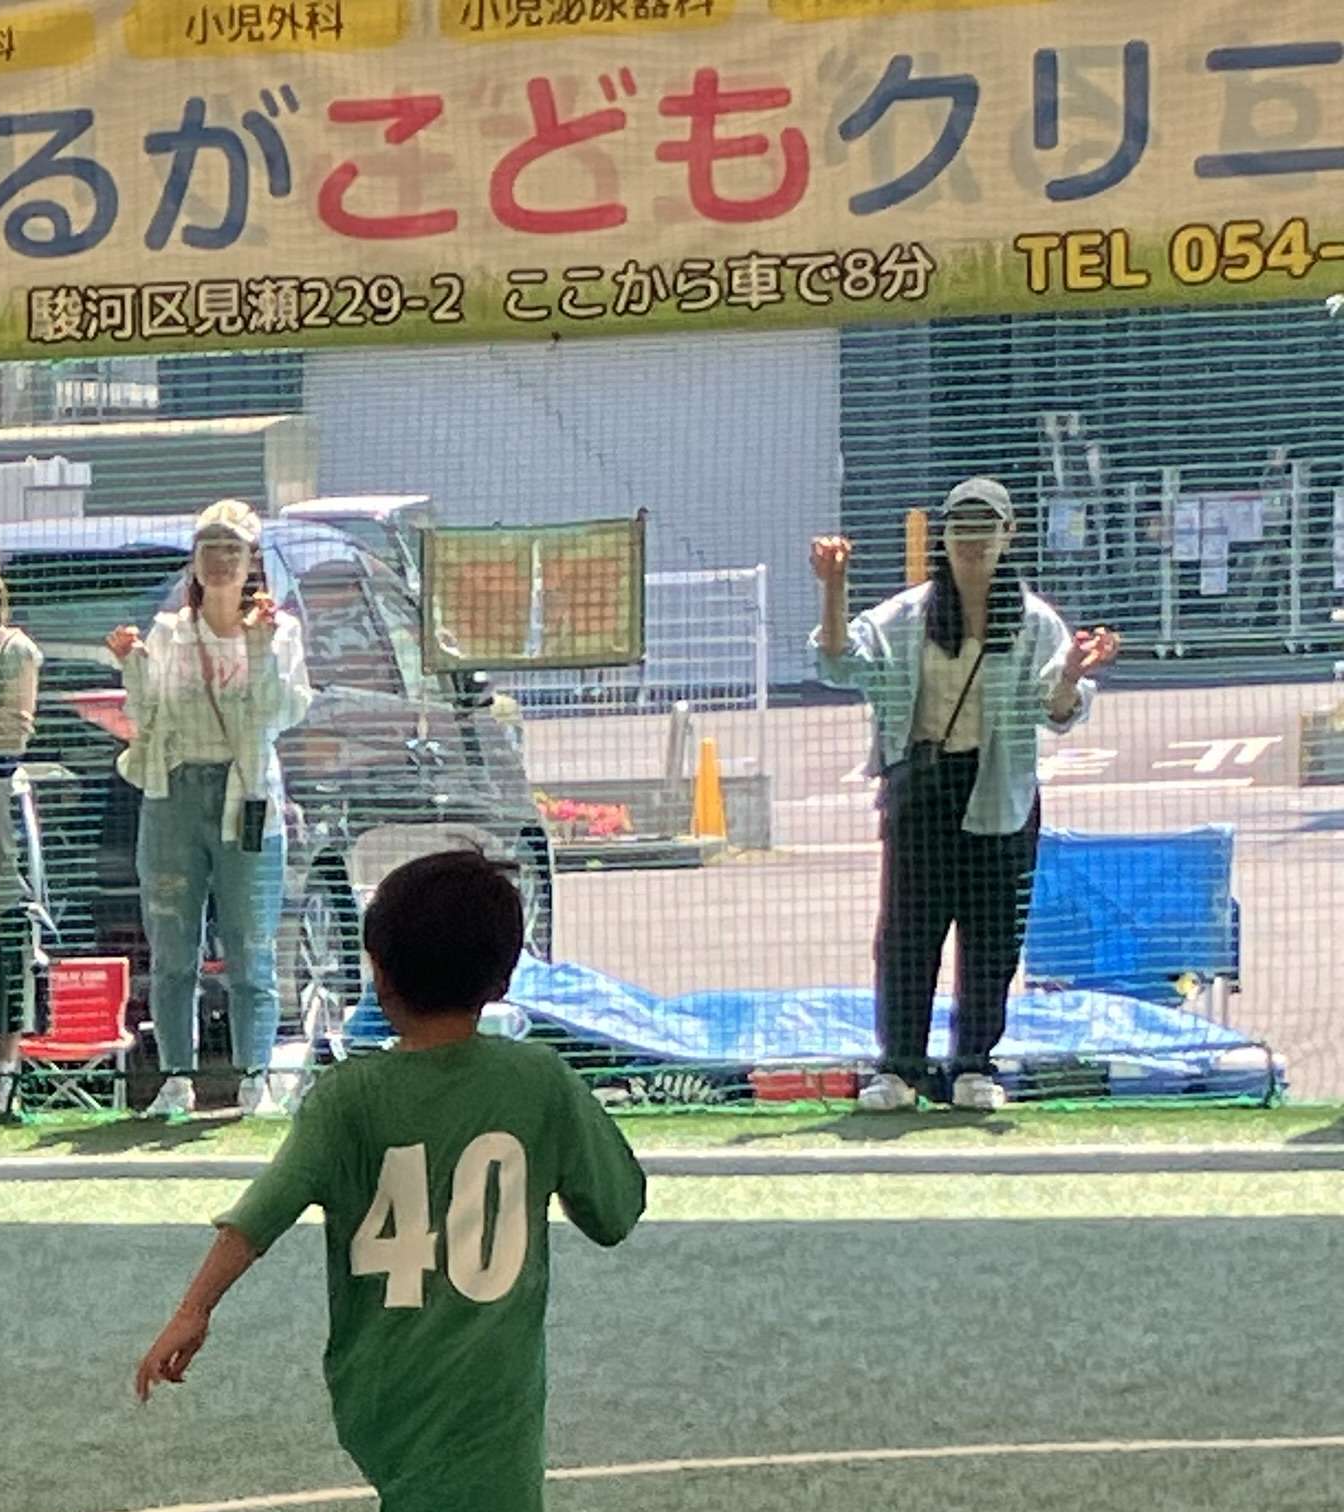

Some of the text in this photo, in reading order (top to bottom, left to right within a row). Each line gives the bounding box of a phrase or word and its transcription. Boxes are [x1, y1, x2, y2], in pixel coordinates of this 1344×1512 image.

[185, 3, 344, 45] 小児外科
[28, 275, 464, 343] 駿河区見瀬229-2
[504, 243, 935, 320] ここから車で8分
[1015, 230, 1149, 294] TEL
[349, 1131, 528, 1308] 40
